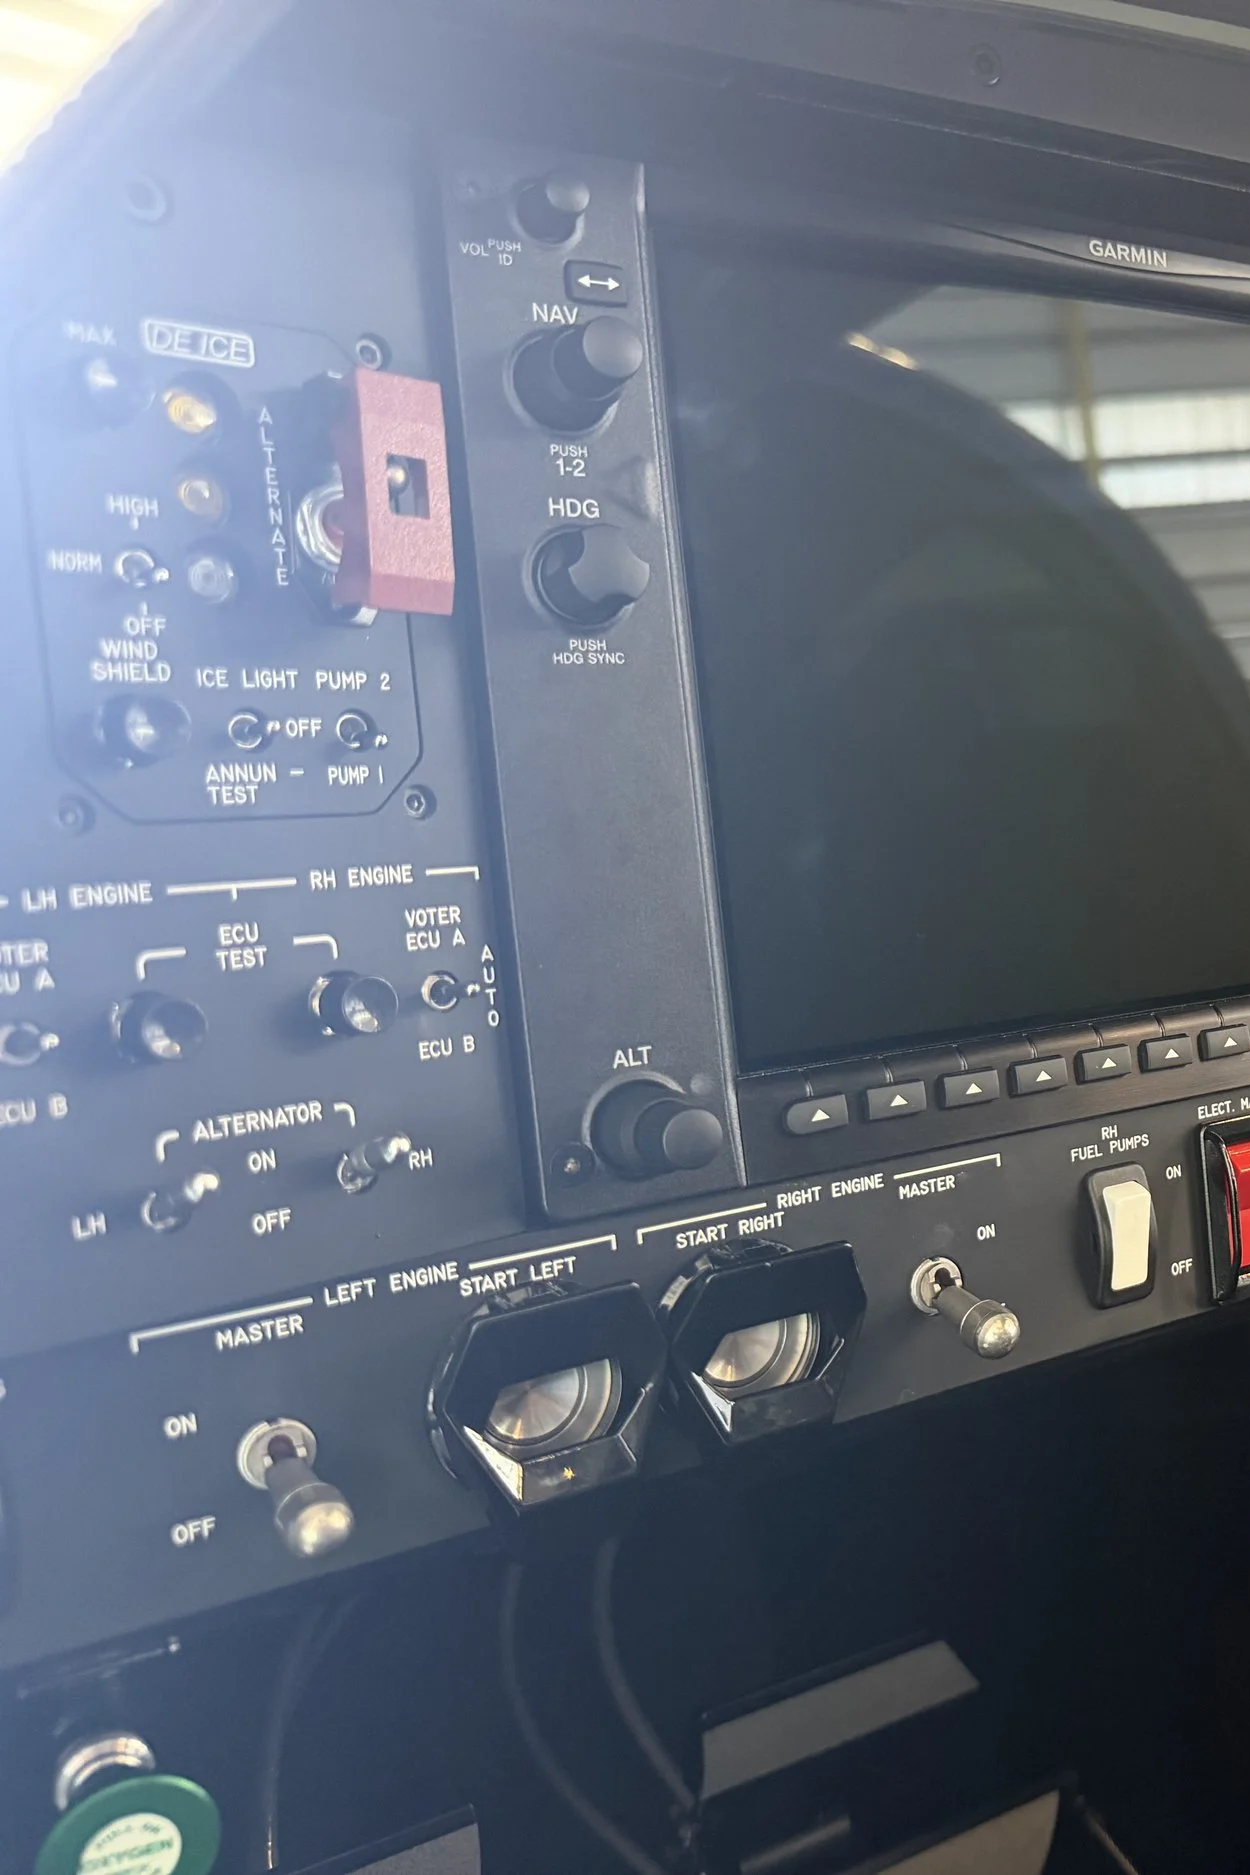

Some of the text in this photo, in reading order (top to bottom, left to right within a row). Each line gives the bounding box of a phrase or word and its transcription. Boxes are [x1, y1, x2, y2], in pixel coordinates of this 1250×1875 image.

[460, 238, 521, 257] VOL PUSH
[498, 253, 513, 266] ID
[1089, 239, 1168, 269] GARMIN
[531, 302, 579, 325] NAV
[152, 325, 250, 363] DE ICE
[550, 444, 588, 458] PUSH
[555, 458, 586, 477] 1-2
[106, 495, 160, 520] HIGH
[548, 497, 600, 519] HDG
[50, 549, 103, 574] NORM
[124, 616, 167, 638] OFF
[100, 639, 158, 662] WIND
[569, 639, 607, 651] PUSH
[553, 652, 625, 666] HDG SYNC
[91, 661, 172, 685] SHIELD
[196, 668, 299, 691] ICE LIGHT
[315, 670, 391, 692] PUMP 2
[285, 717, 323, 738] OFF
[205, 763, 277, 784] ANNUN
[328, 765, 385, 786] PUMP 1
[206, 784, 259, 804] TEST
[309, 864, 414, 890] RH ENGINE
[21, 881, 153, 913] LH ENGINE
[404, 906, 462, 928] VOTER
[219, 922, 260, 946] ECU
[406, 927, 466, 952] ECU A
[0, 940, 48, 966] TER
[215, 946, 268, 972] TEST
[34, 967, 56, 993] A
[480, 944, 500, 1028] AUTO
[418, 1034, 476, 1061] ECU B
[613, 1046, 652, 1069] ALT
[49, 1093, 69, 1120] B
[1197, 1099, 1236, 1120] ELECT.
[192, 1101, 323, 1143] ALTERNATOR
[1101, 1124, 1118, 1141] RH
[407, 1147, 434, 1171] RH
[1071, 1133, 1150, 1163] FUEL PUMPS
[248, 1149, 277, 1174] ON
[1166, 1164, 1182, 1181] ON
[776, 1172, 886, 1210] RIGHT ENGINE
[898, 1174, 957, 1201] MASTER
[71, 1211, 108, 1242] LH
[252, 1208, 292, 1237] OFF
[676, 1210, 786, 1249] START RIGHT
[976, 1223, 997, 1242] ON
[458, 1255, 578, 1298] START LEFT
[1171, 1258, 1193, 1277] OFF
[323, 1261, 460, 1308] LEFT ENGINE
[215, 1315, 306, 1351] MASTER
[164, 1412, 200, 1440] ON
[170, 1513, 218, 1548] OFF
